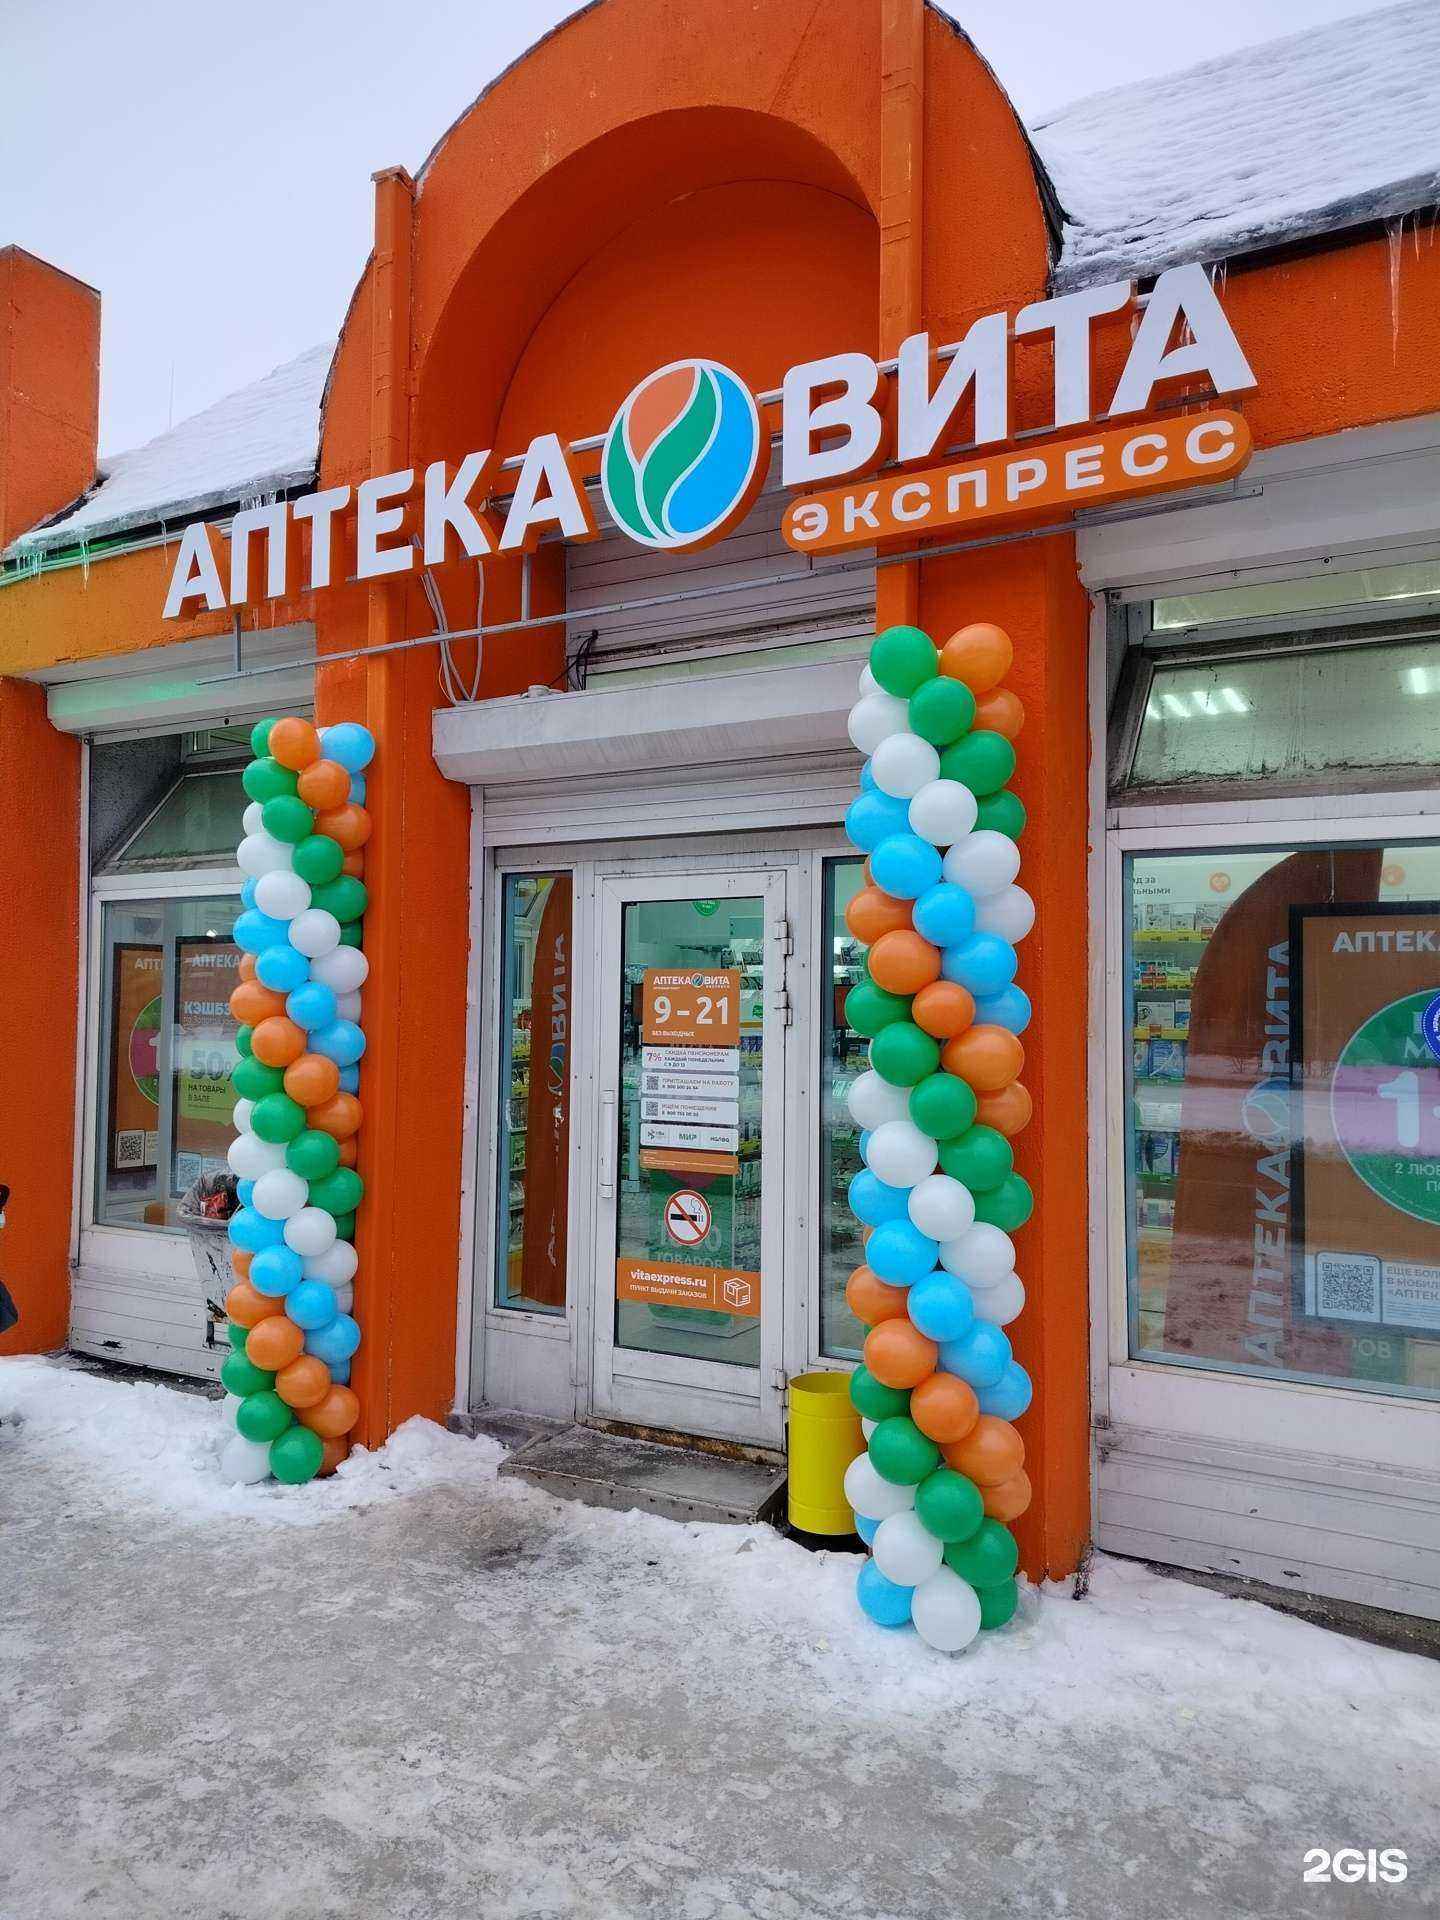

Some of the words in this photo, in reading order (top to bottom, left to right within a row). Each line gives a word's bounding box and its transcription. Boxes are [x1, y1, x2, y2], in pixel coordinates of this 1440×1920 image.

[162, 433, 588, 619] АПТЕКА
[781, 264, 1258, 487] ВИТА
[790, 418, 1238, 542] ЭКСПРЕСС
[653, 976, 691, 985] АПТЕКА
[704, 976, 730, 985] ВИТА
[630, 1269, 707, 1288] vitaexpress.ru
[1241, 1150, 1291, 1367] АПТЕКА
